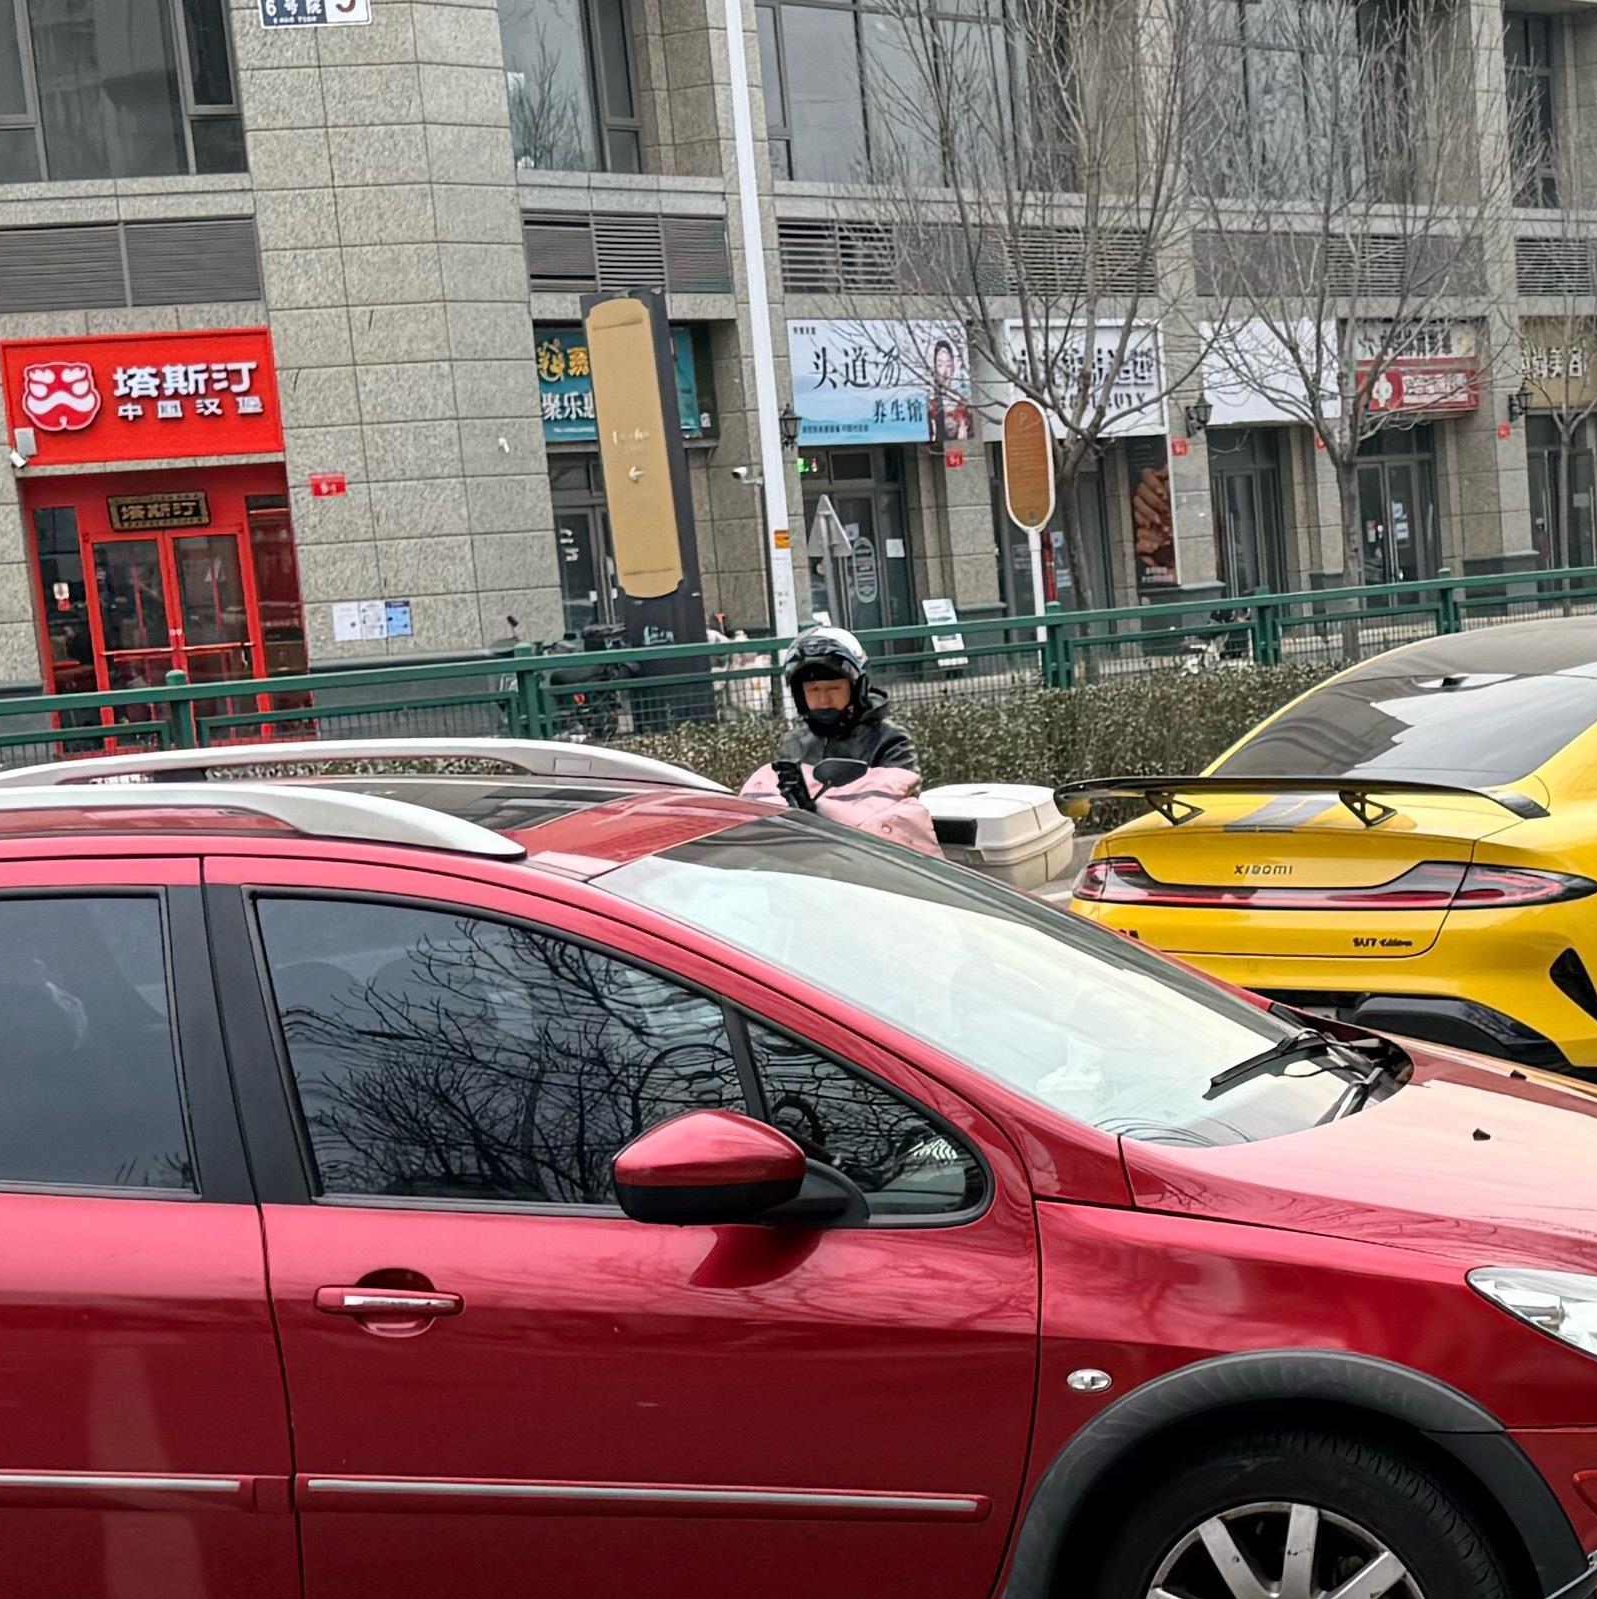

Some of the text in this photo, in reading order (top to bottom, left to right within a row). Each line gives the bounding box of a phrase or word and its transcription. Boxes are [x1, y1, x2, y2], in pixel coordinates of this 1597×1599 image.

[113, 361, 258, 399] 塔斯汀
[809, 345, 902, 390] 头道汤
[117, 396, 264, 421] 中国汉堡
[873, 394, 924, 424] 养生馆
[120, 501, 196, 522] 塔斯汀
